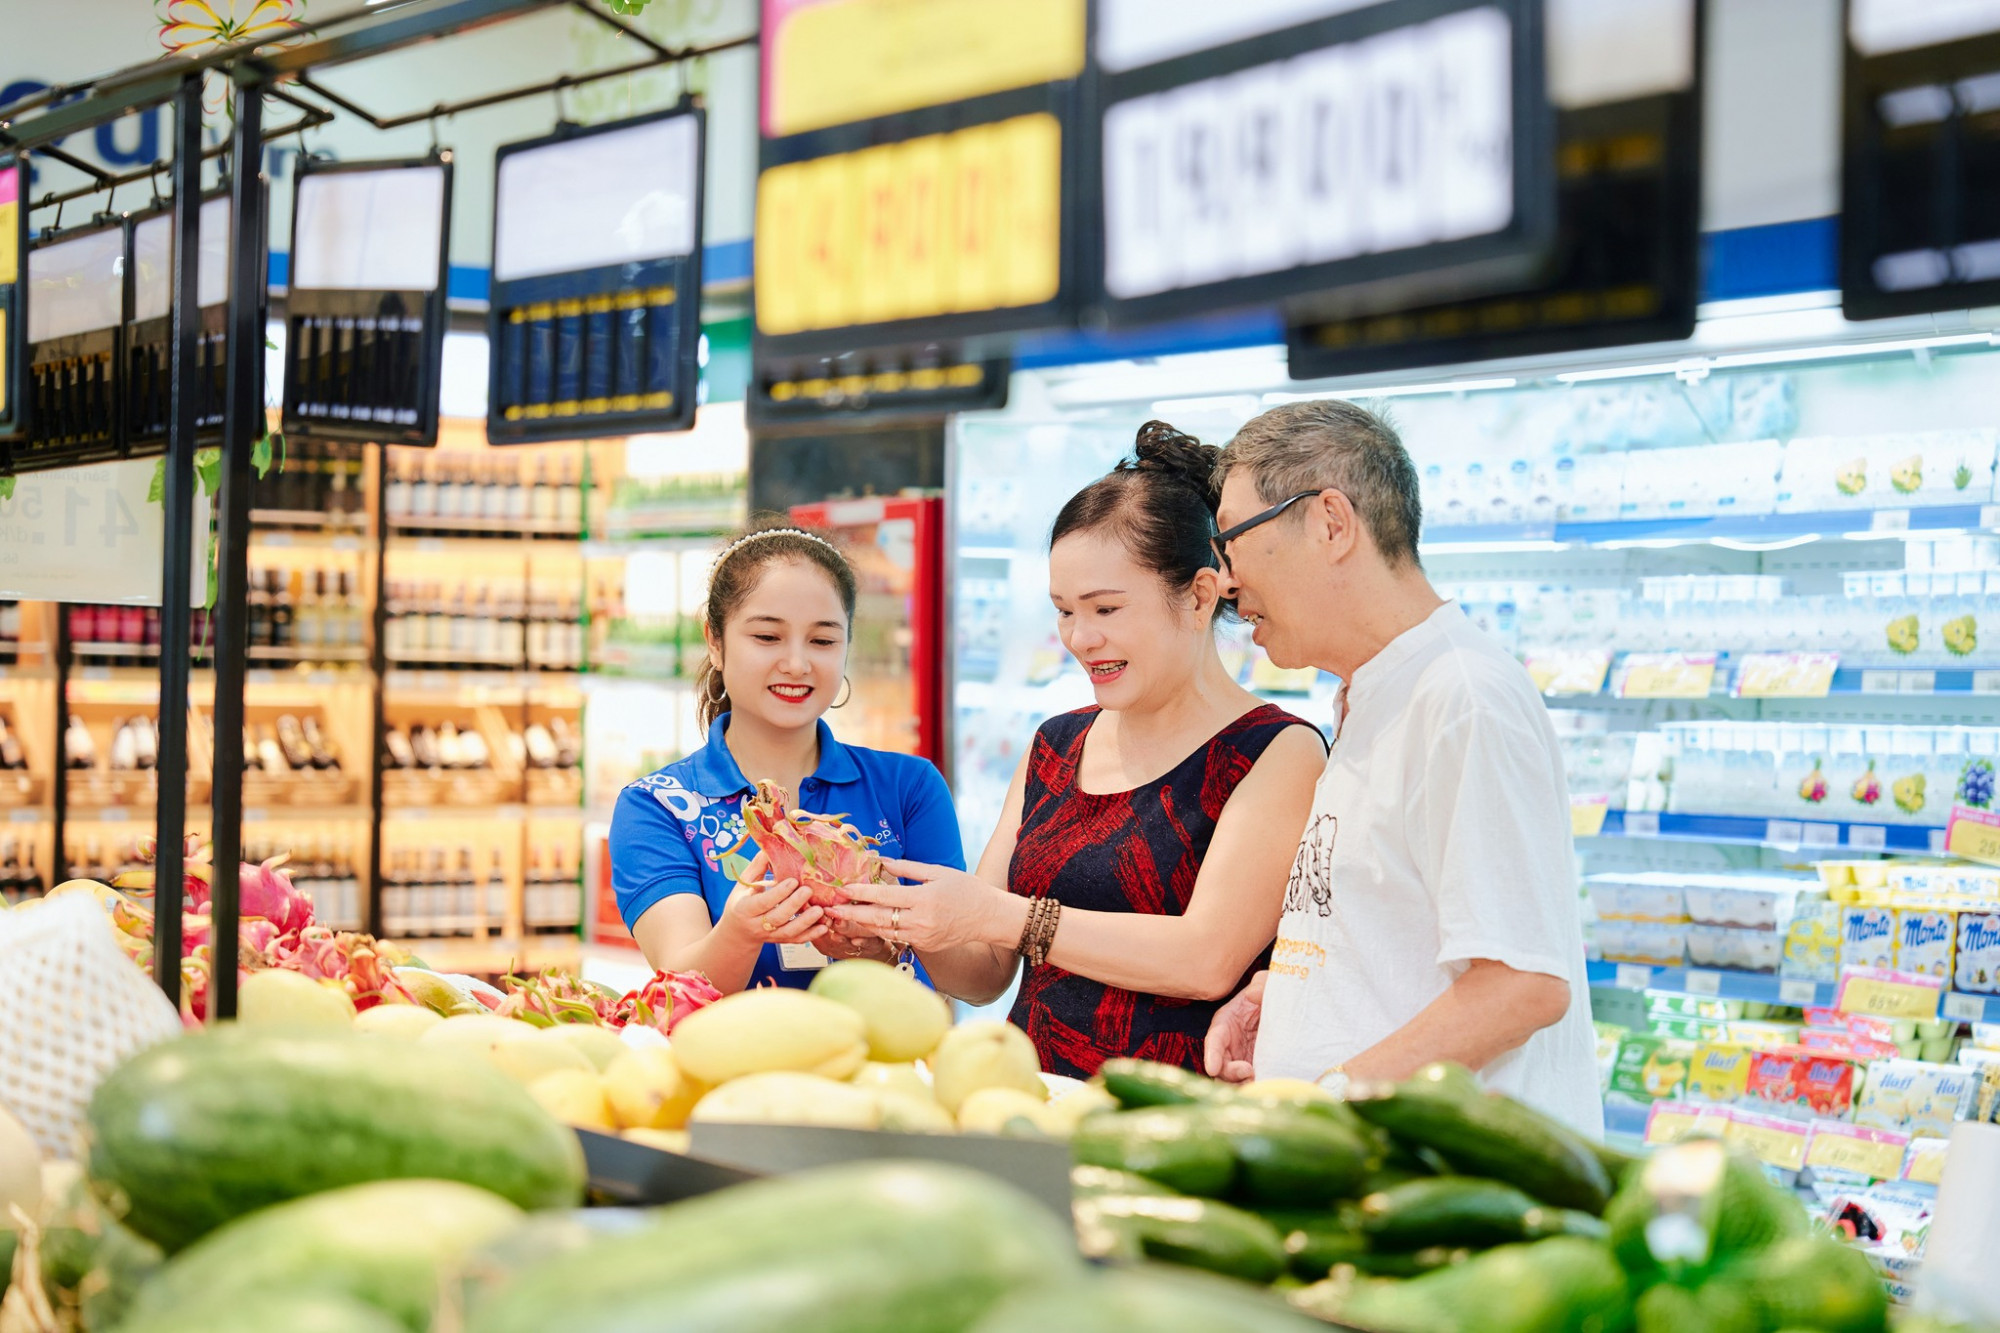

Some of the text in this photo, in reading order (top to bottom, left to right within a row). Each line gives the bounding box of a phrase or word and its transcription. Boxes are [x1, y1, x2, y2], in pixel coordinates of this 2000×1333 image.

[1848, 914, 1890, 942] Monte
[1905, 917, 1948, 947] Monte
[1880, 1073, 1914, 1091] Hoff
